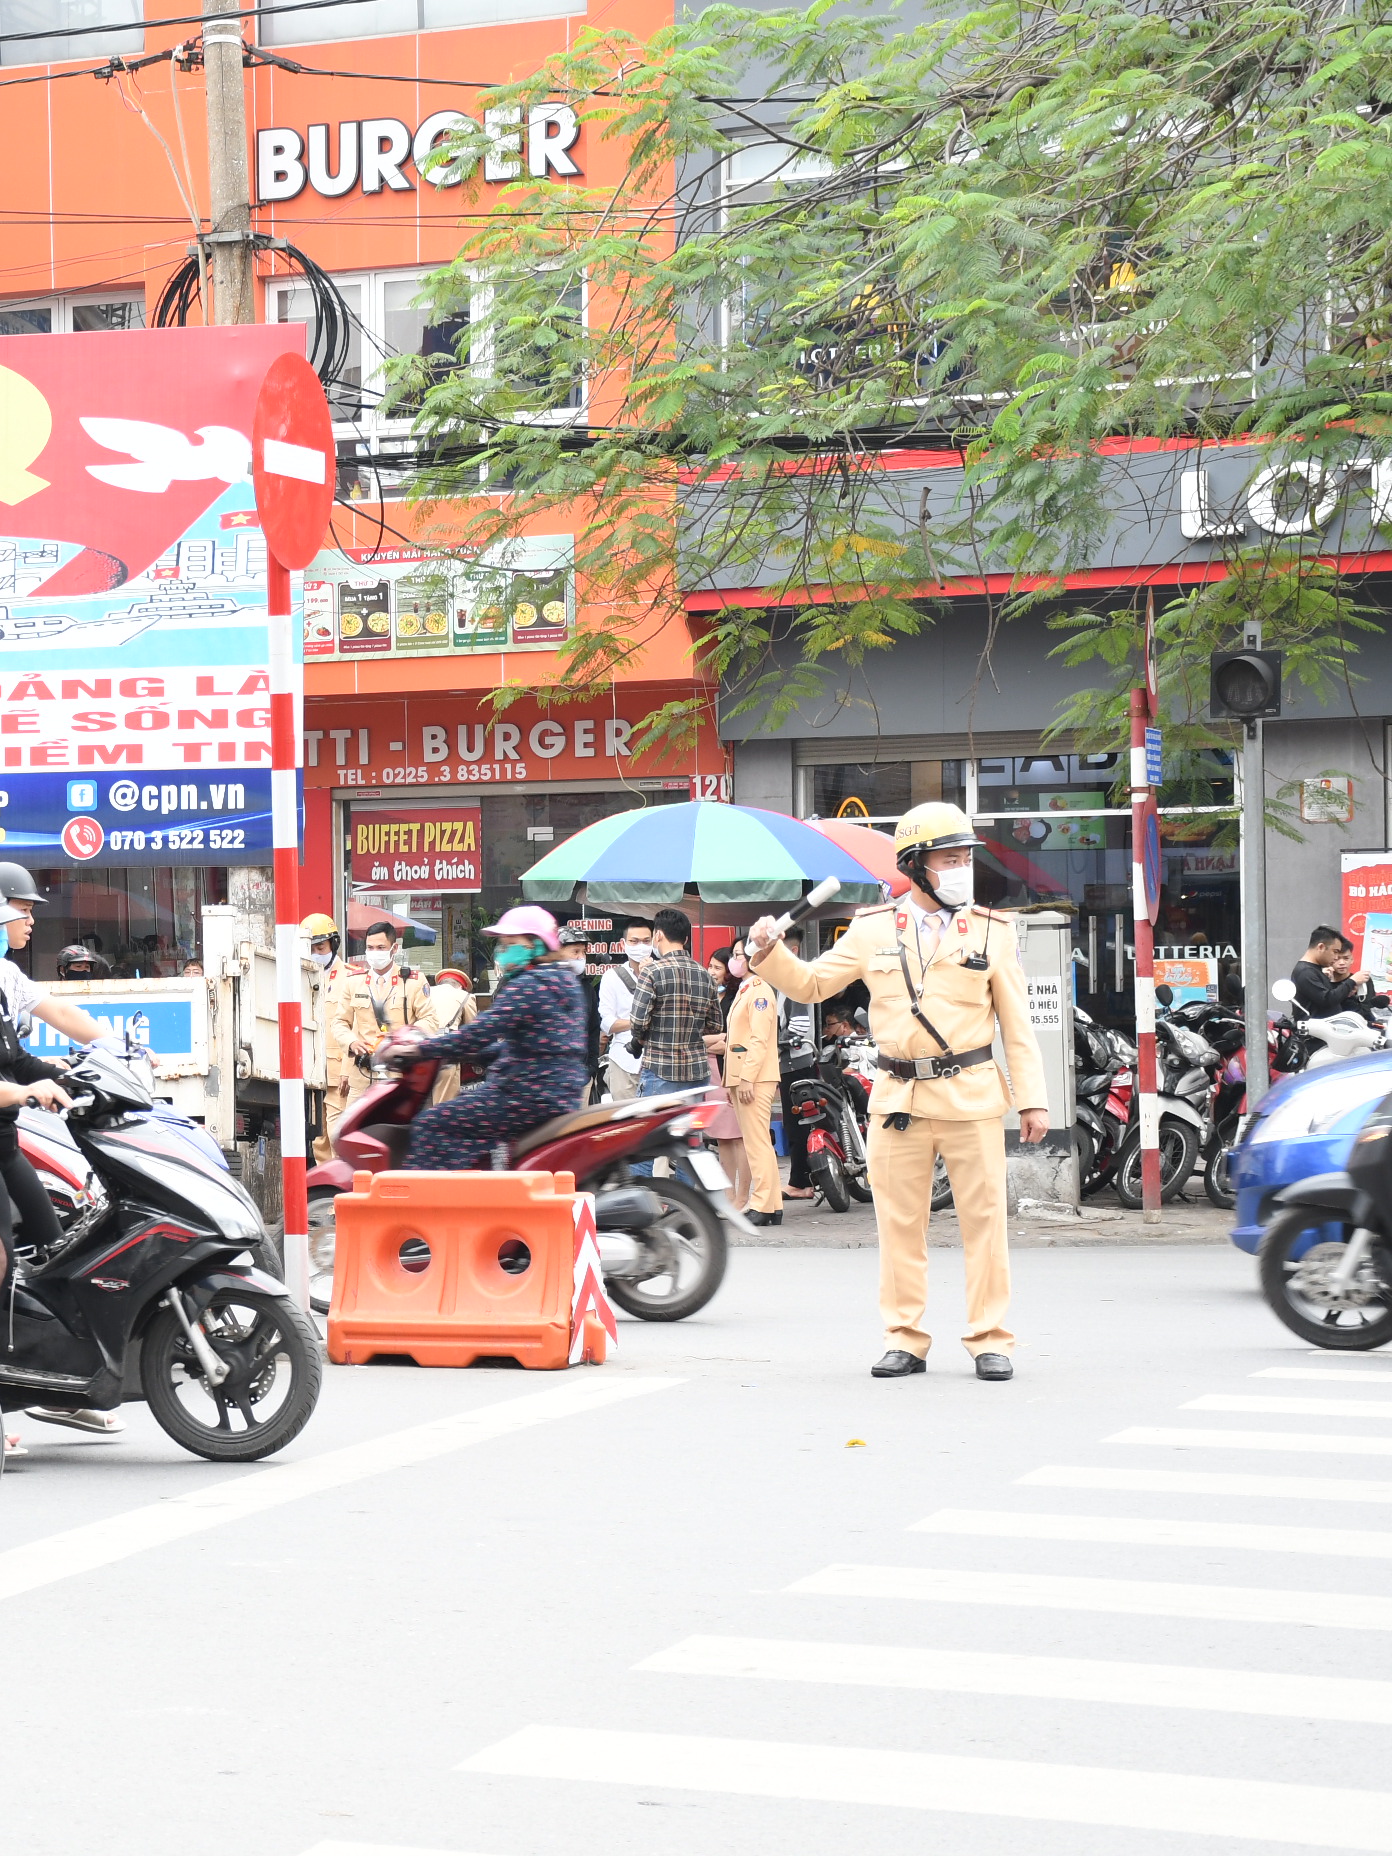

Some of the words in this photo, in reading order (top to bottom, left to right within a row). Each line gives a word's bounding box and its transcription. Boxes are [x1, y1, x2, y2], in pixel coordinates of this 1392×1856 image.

[256, 101, 584, 202] BURGER
[71, 701, 272, 732] SỐNG
[422, 719, 635, 763] BURGER
[338, 769, 366, 786] TEL
[382, 766, 428, 784] 0225
[457, 763, 527, 781] 835115
[109, 779, 245, 815] @cpn.vn
[110, 831, 144, 850] 070
[151, 831, 163, 850] 3
[168, 830, 205, 850] 522
[210, 829, 245, 849] 522
[356, 821, 420, 855] BUFFET
[424, 821, 476, 852] PIZZA
[895, 824, 921, 841] CSGT
[371, 861, 388, 881] ăn
[436, 857, 475, 880] thích
[567, 919, 612, 931] OPENING
[1127, 945, 1238, 960] LTTERIA
